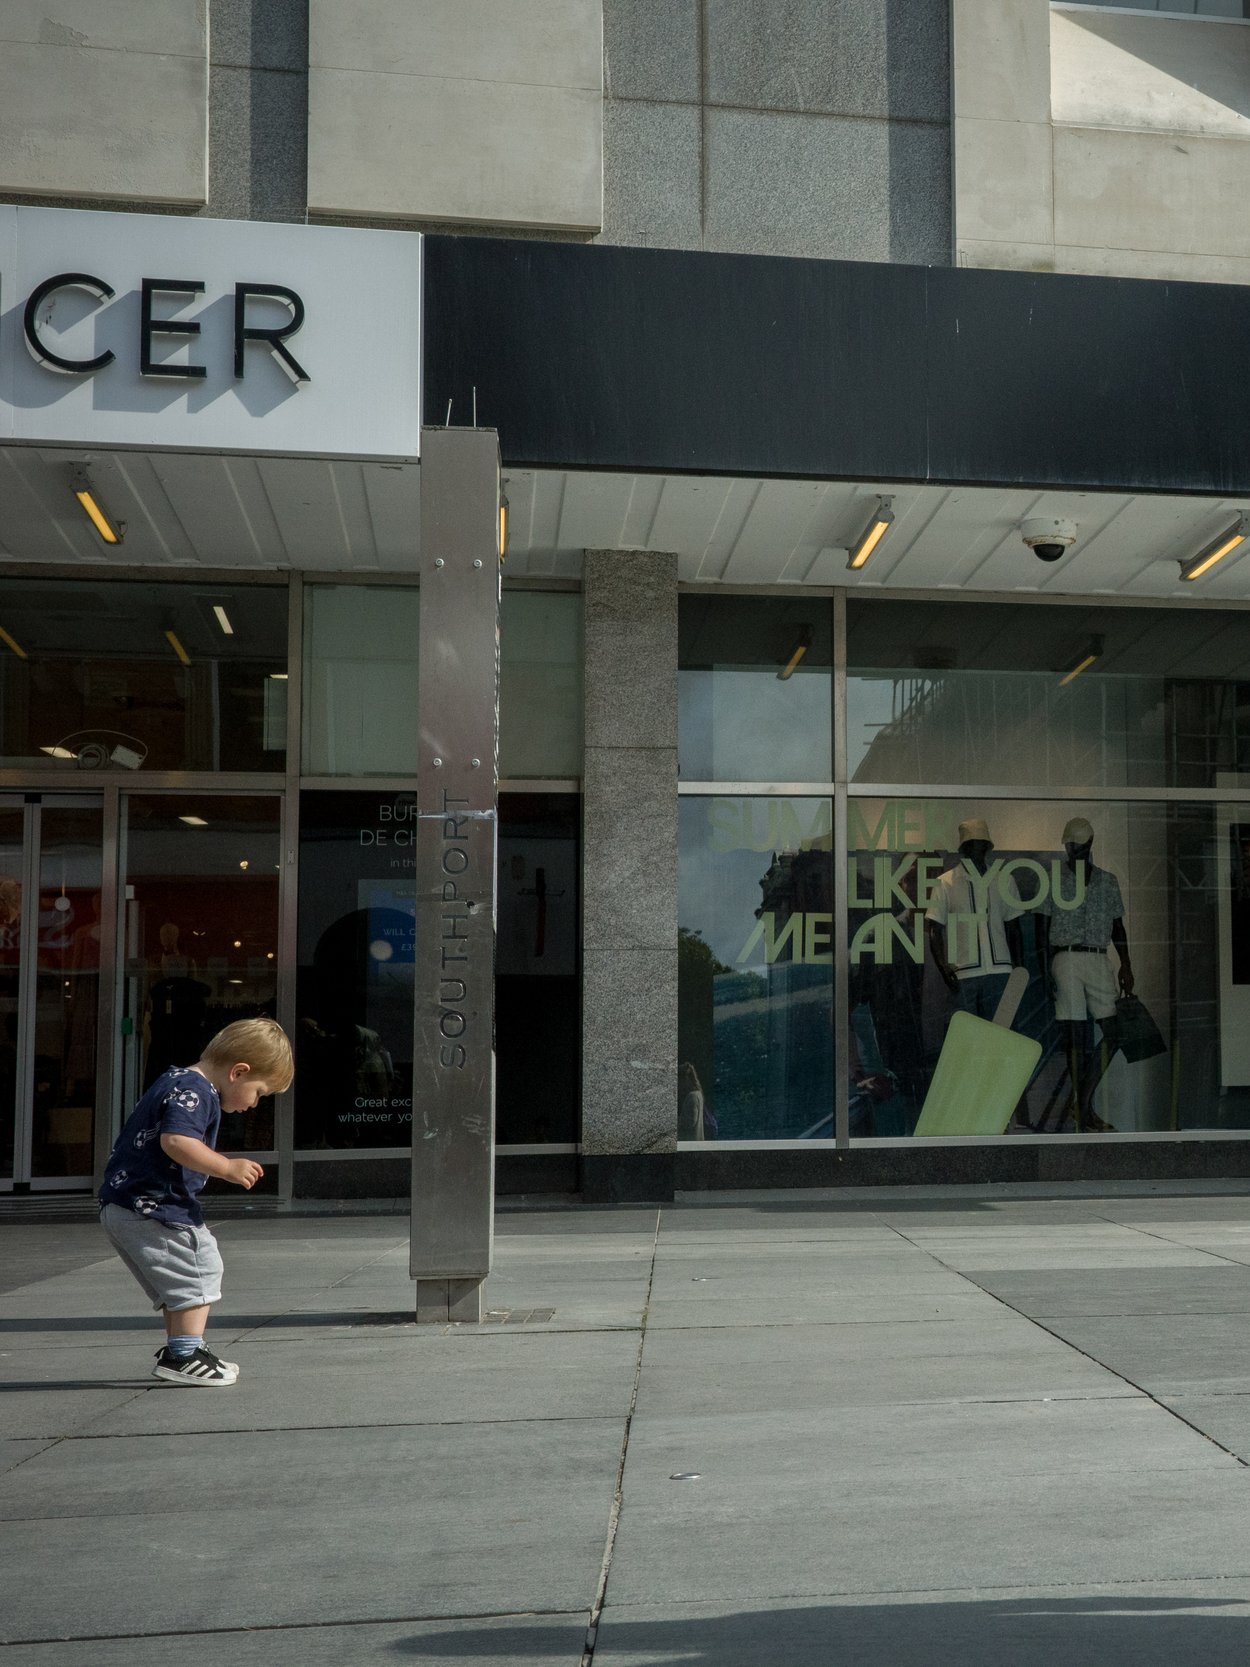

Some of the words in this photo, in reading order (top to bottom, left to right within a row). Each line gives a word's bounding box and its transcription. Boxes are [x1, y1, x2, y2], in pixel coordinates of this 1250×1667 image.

[0, 272, 312, 381] CER
[360, 830, 387, 846] DE
[848, 857, 943, 909] LIKE
[961, 857, 1085, 911] YOU
[439, 788, 469, 1070] SOUTHPORT
[736, 912, 925, 964] MEAN
[947, 912, 988, 965] IT
[338, 1112, 393, 1122] whatever
[354, 1097, 388, 1108] Great
